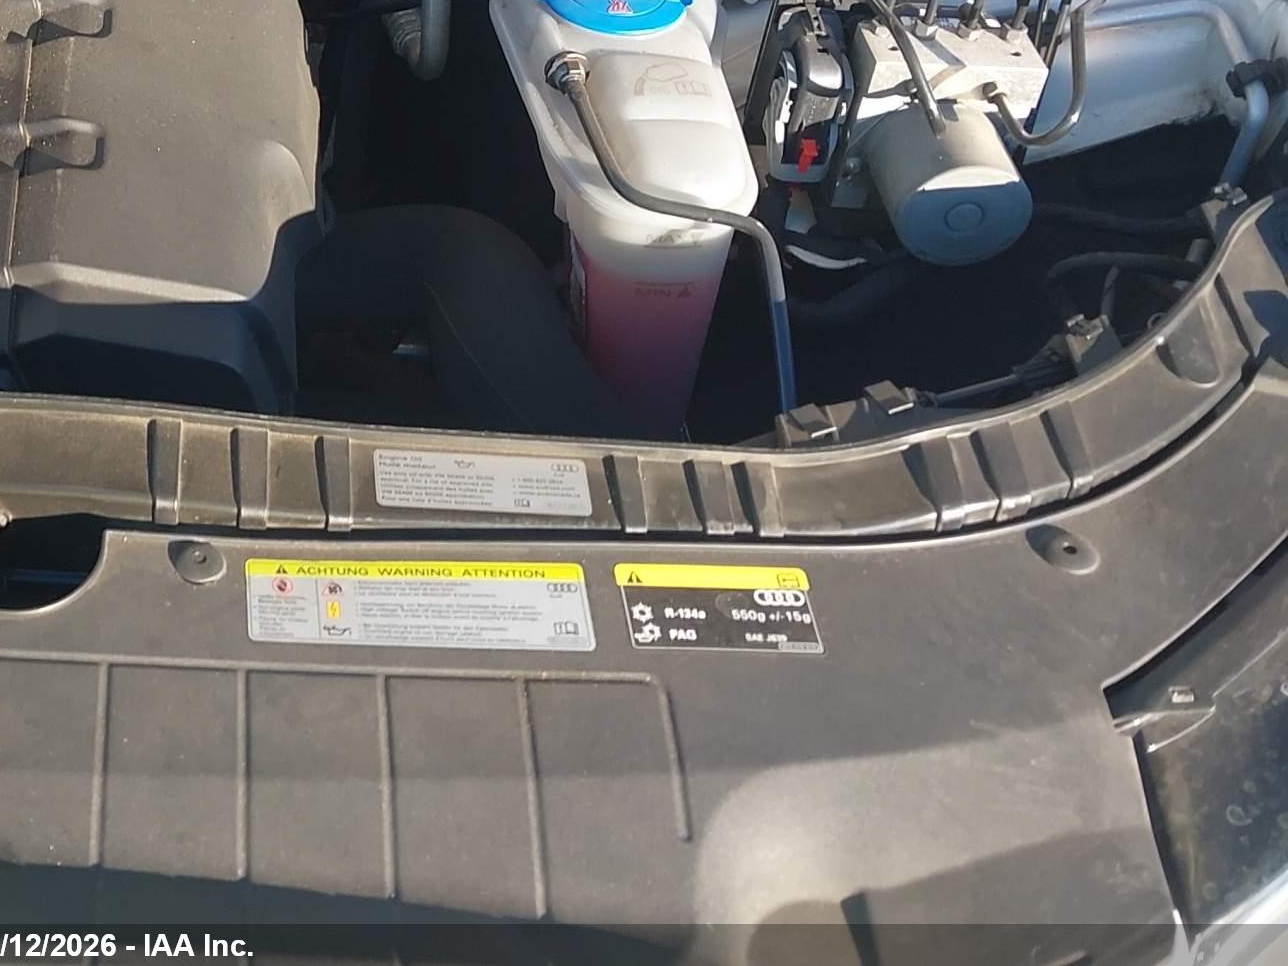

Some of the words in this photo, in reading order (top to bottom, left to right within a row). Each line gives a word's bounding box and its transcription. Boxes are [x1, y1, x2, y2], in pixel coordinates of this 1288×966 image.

[295, 565, 370, 577] ACHTUNG
[377, 567, 453, 578] WARNING
[461, 568, 547, 579] ATTENTION
[664, 607, 707, 619] R-134a
[731, 609, 767, 624] 550g
[669, 628, 697, 641] PAG
